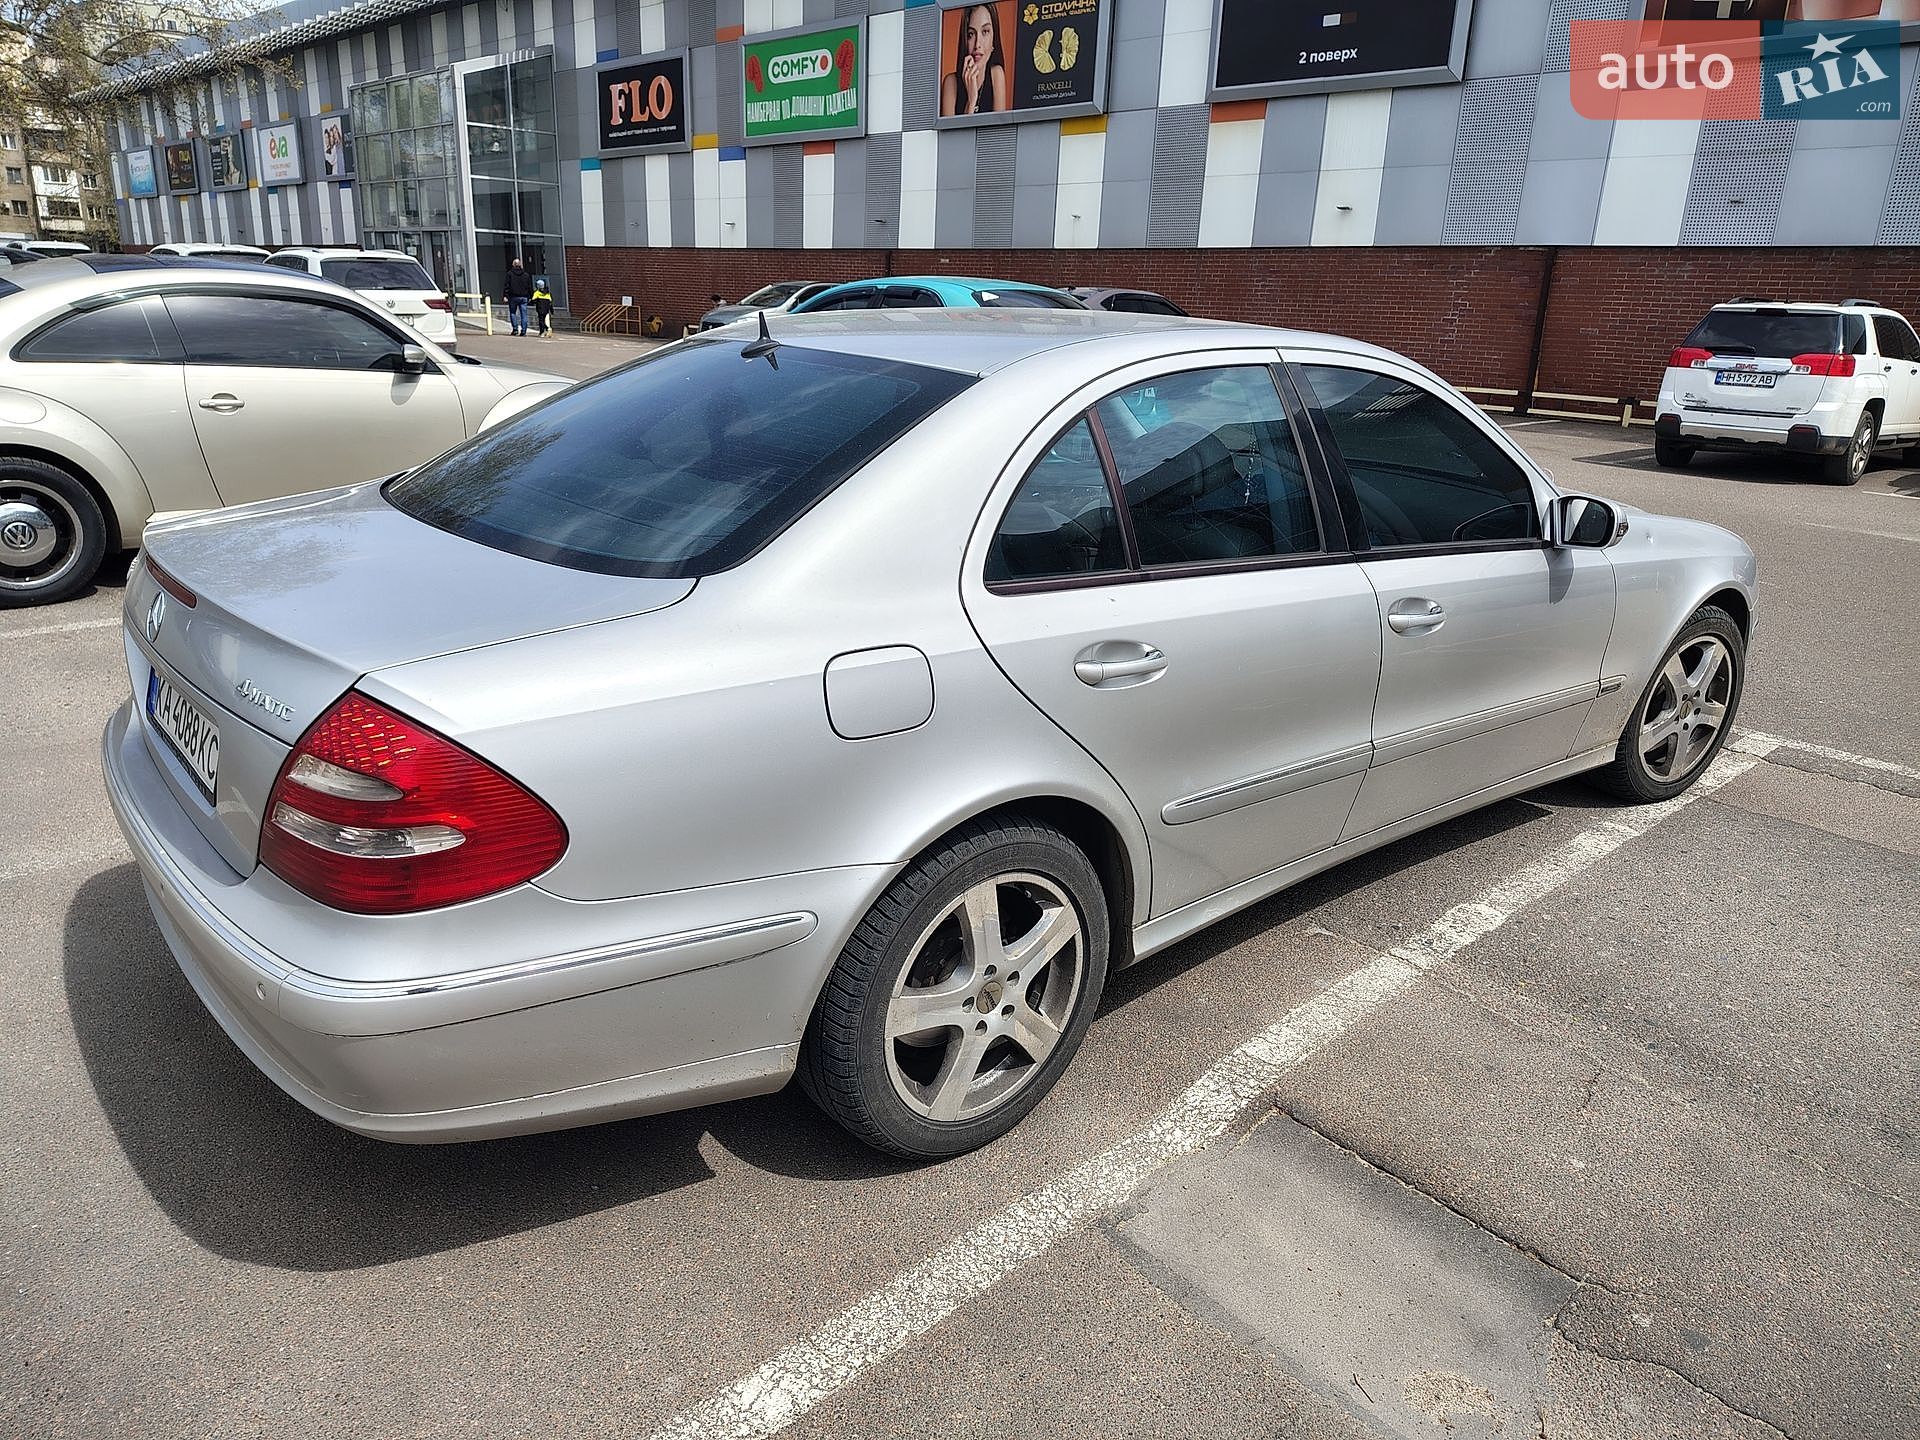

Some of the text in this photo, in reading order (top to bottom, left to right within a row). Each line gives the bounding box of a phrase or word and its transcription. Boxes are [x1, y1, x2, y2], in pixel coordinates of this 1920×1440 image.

[1042, 0, 1096, 14] СТОЛИЧНА
[1299, 48, 1358, 64] 2 поверх
[772, 55, 818, 79] COMFY
[1038, 80, 1072, 92] FRANCELLI
[609, 75, 673, 126] FLO
[1721, 372, 1773, 385] HH 5172 AB
[235, 679, 296, 722] 4MATIC
